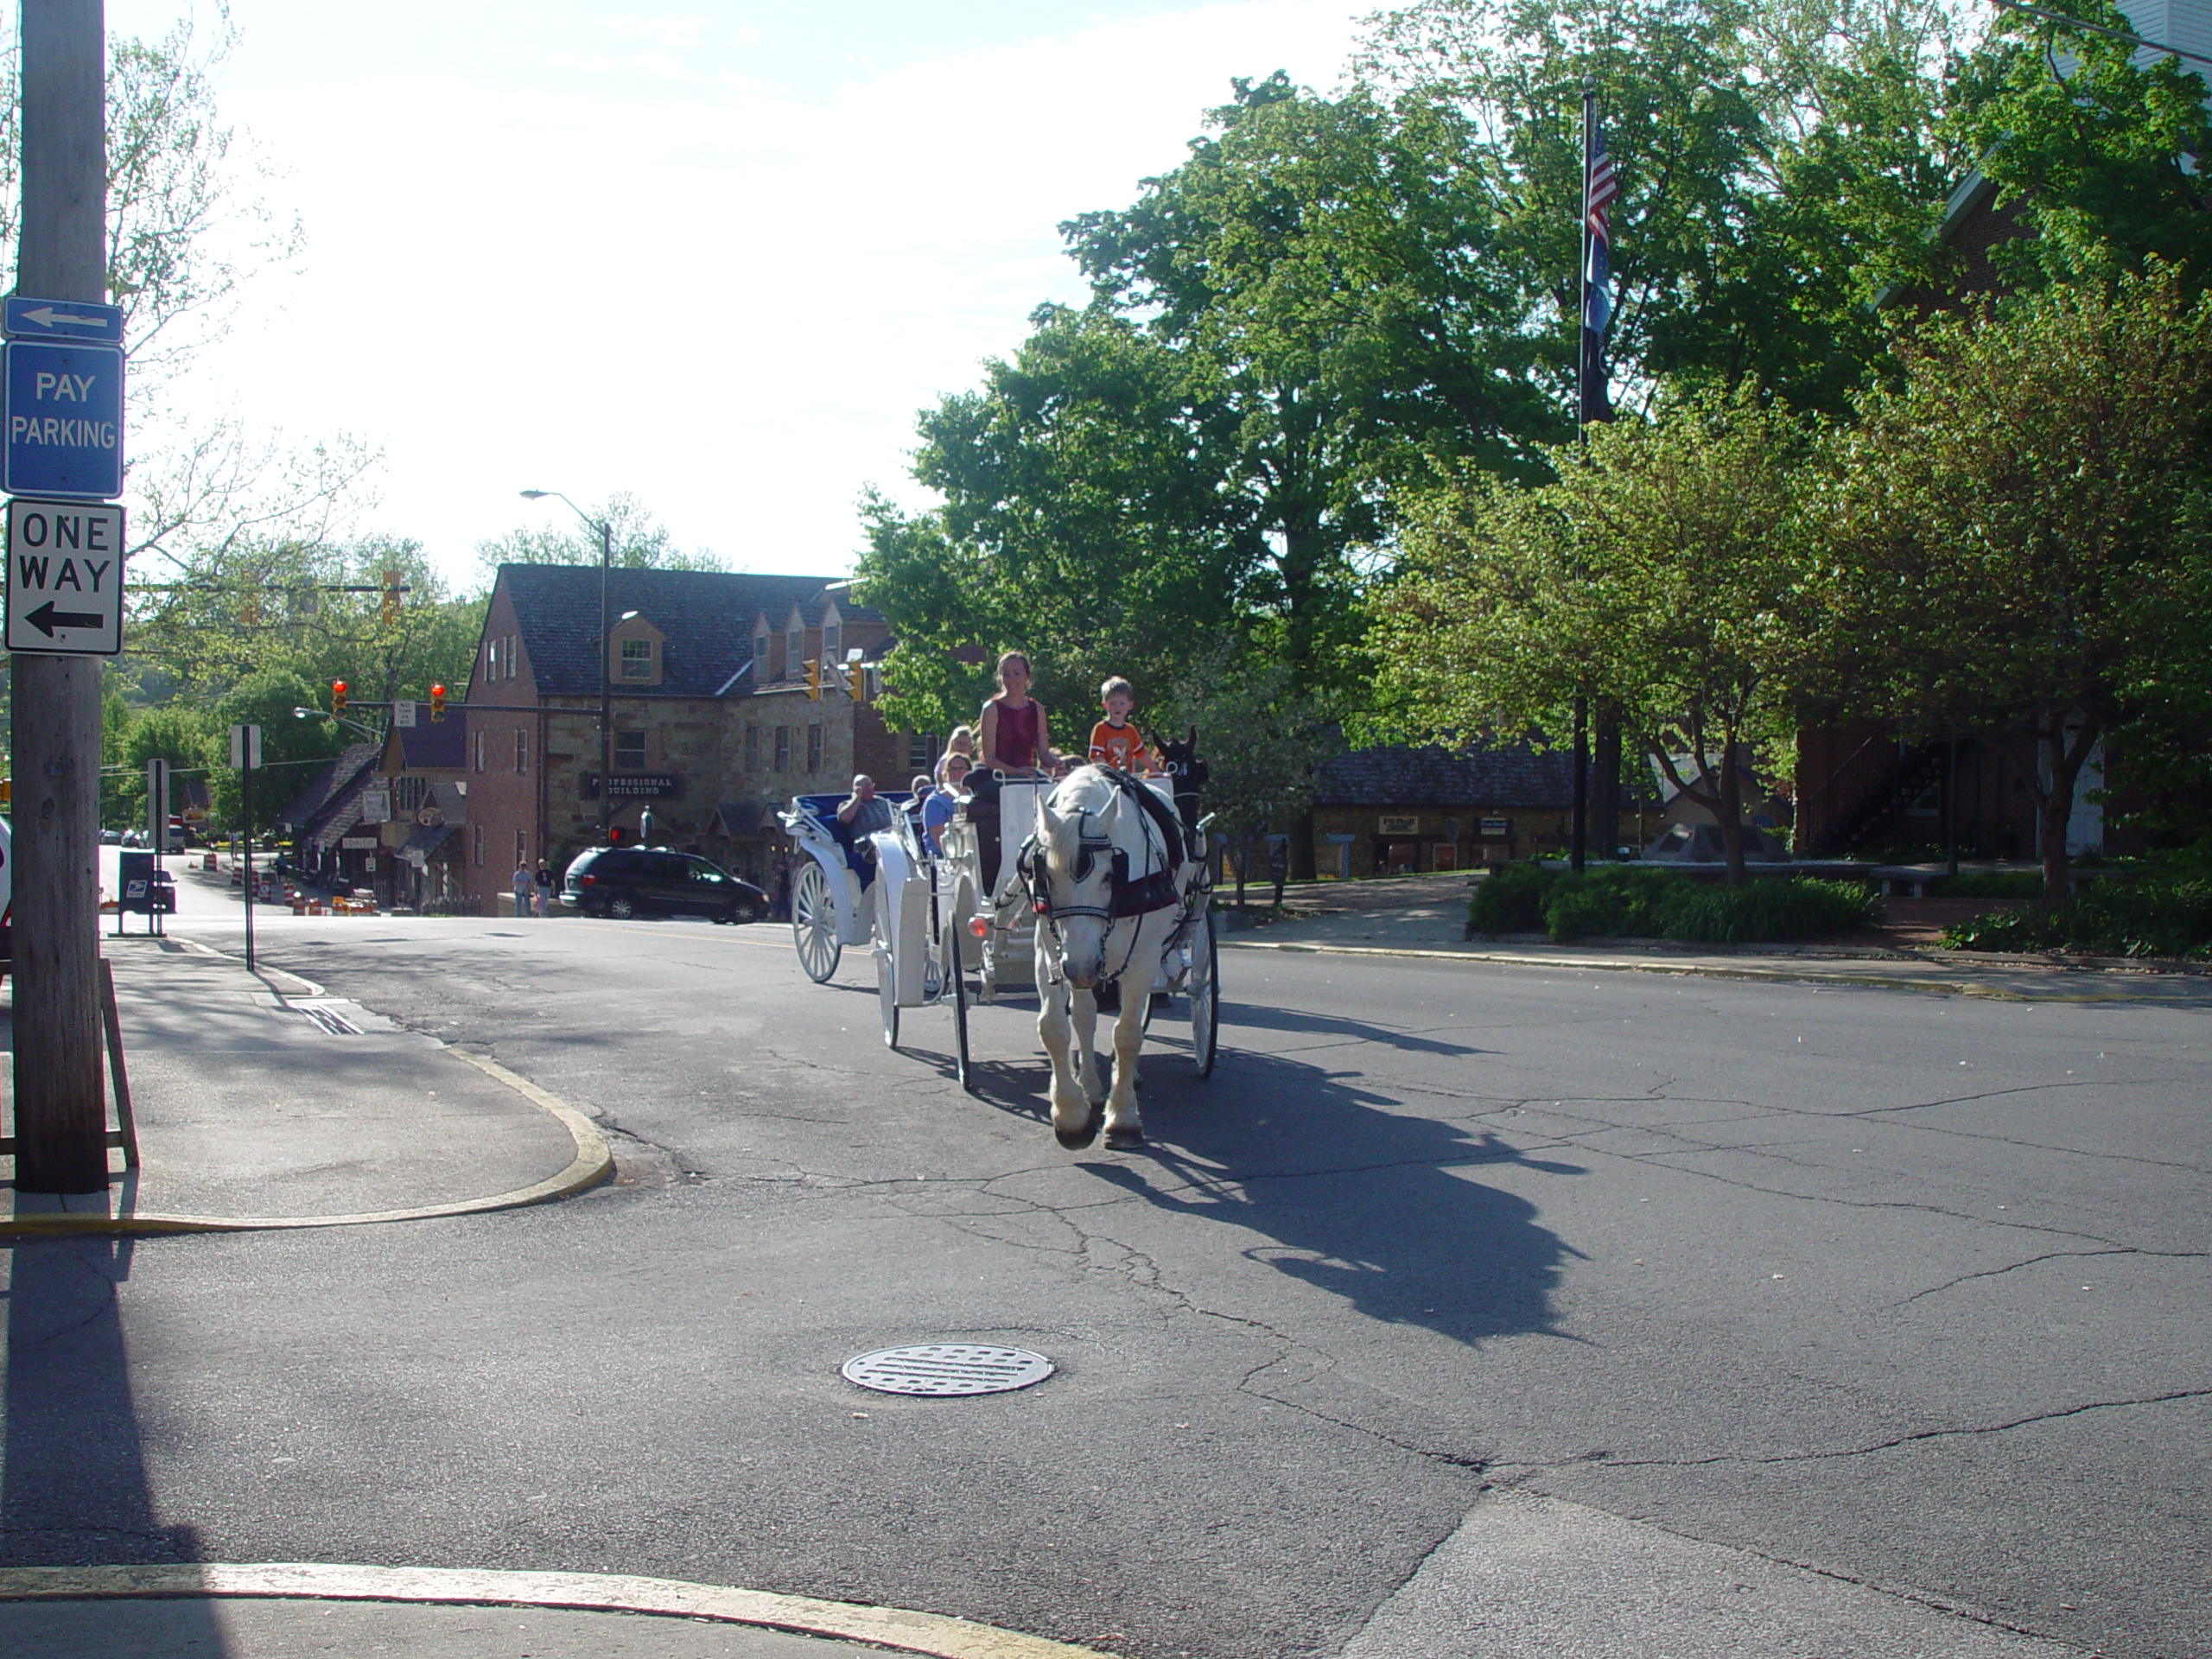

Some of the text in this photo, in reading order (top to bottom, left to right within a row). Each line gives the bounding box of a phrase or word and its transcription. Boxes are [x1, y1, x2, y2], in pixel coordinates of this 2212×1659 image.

[35, 372, 96, 403] PAY
[11, 416, 115, 449] PARKING
[22, 513, 109, 551] ONE
[19, 555, 111, 594] WAY
